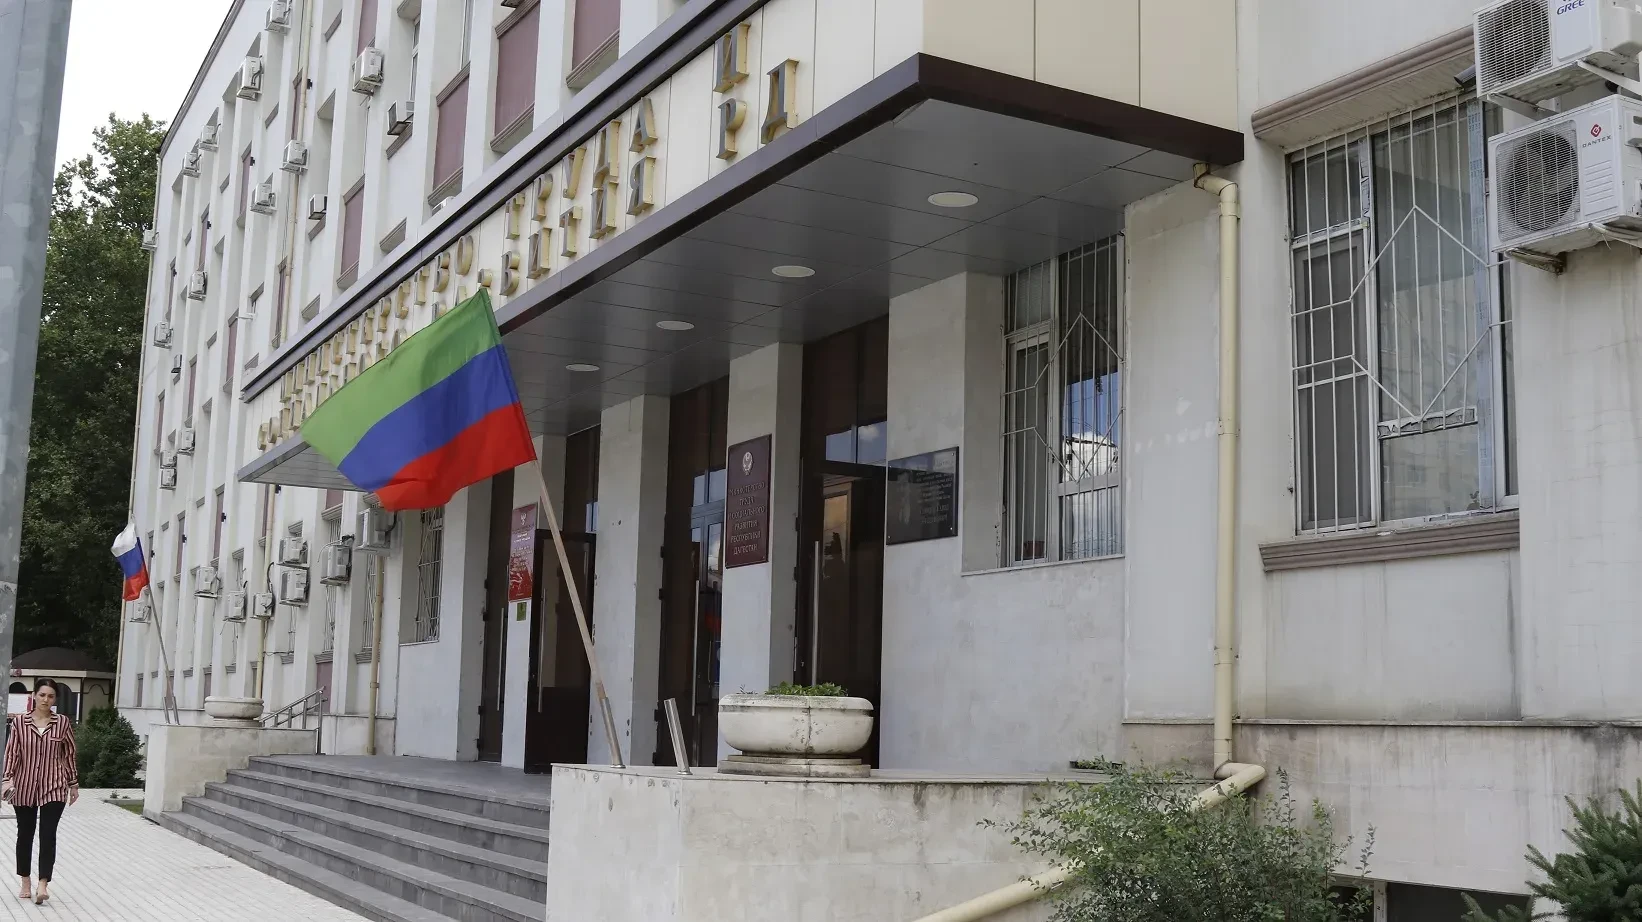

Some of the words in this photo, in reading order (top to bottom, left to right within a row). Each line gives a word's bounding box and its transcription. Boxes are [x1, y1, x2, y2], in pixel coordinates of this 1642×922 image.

[1556, 0, 1585, 15] GREE
[715, 58, 800, 160] РД
[1582, 135, 1612, 148] DANTEX
[279, 235, 474, 403] МИНИСТЕРСТВО
[505, 97, 658, 240] ТРУДА
[713, 22, 751, 93] И
